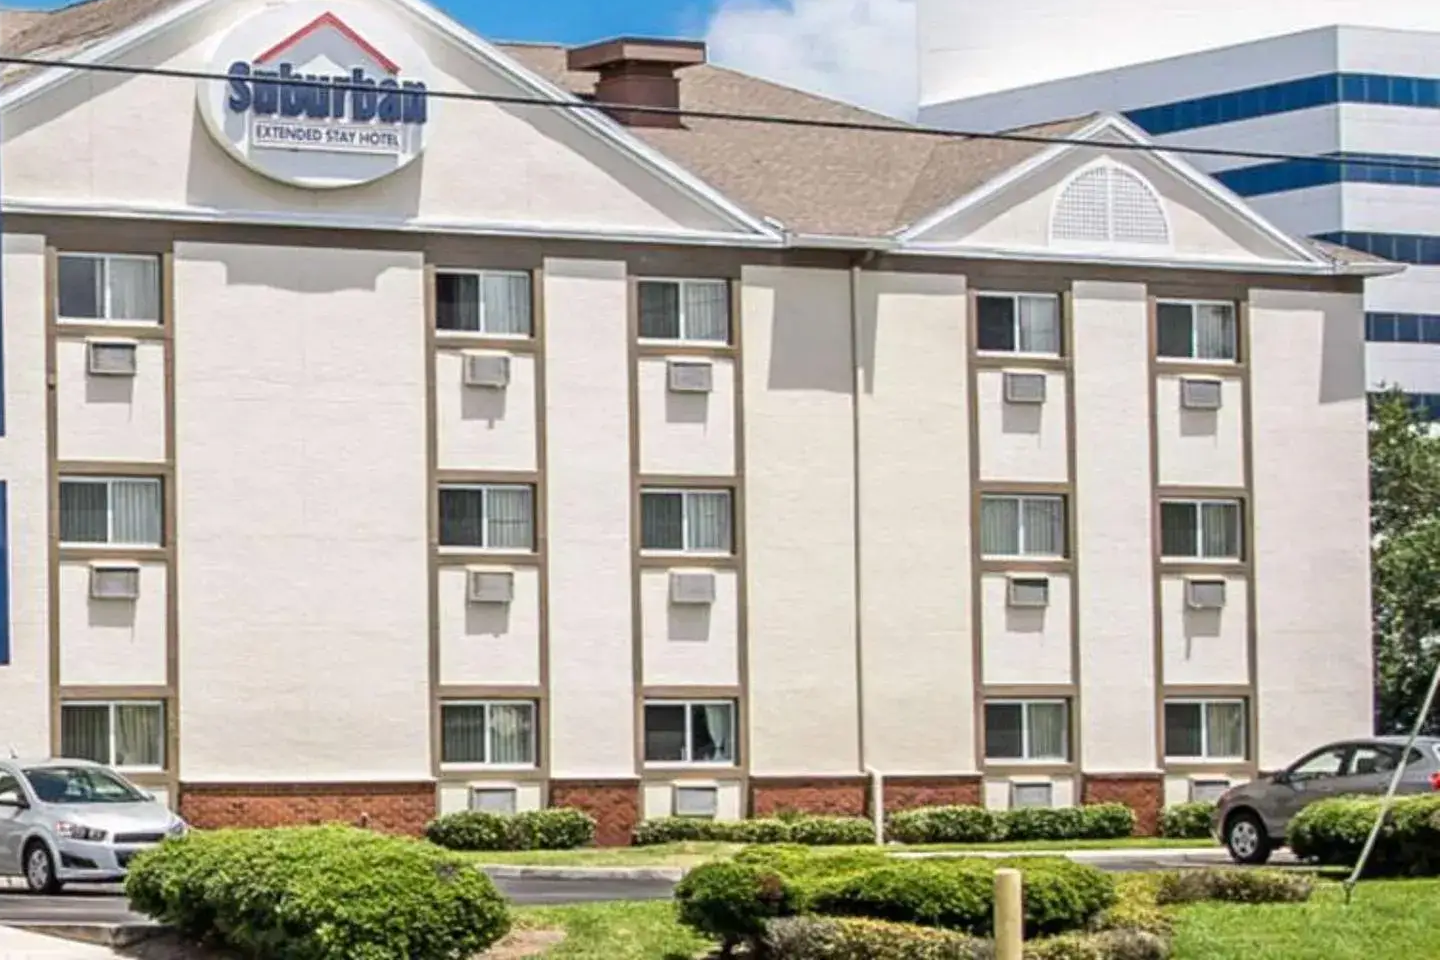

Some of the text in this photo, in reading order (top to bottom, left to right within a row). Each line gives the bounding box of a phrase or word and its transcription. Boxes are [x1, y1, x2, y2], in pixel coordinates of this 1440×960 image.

[228, 61, 427, 124] Suburban
[256, 125, 400, 146] EXTENDED STAY HOTEL
